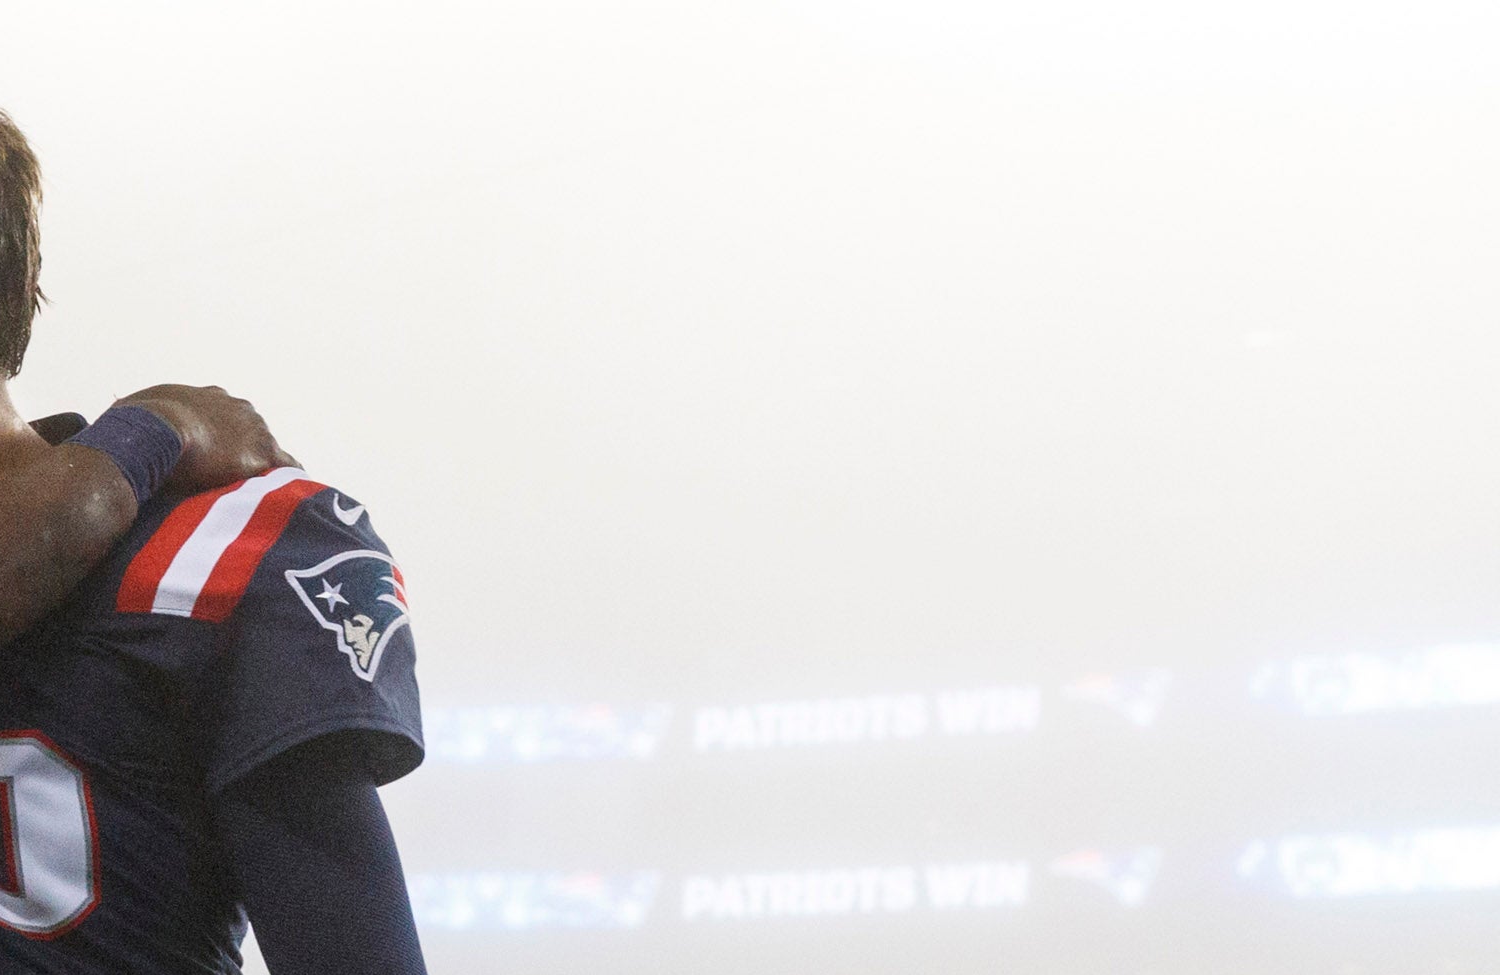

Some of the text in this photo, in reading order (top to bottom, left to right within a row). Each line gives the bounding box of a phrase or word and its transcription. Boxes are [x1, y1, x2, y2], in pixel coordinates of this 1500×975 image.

[694, 684, 1041, 752] PATRIOTS WIN
[682, 860, 1029, 920] PATRIOTS WIN
